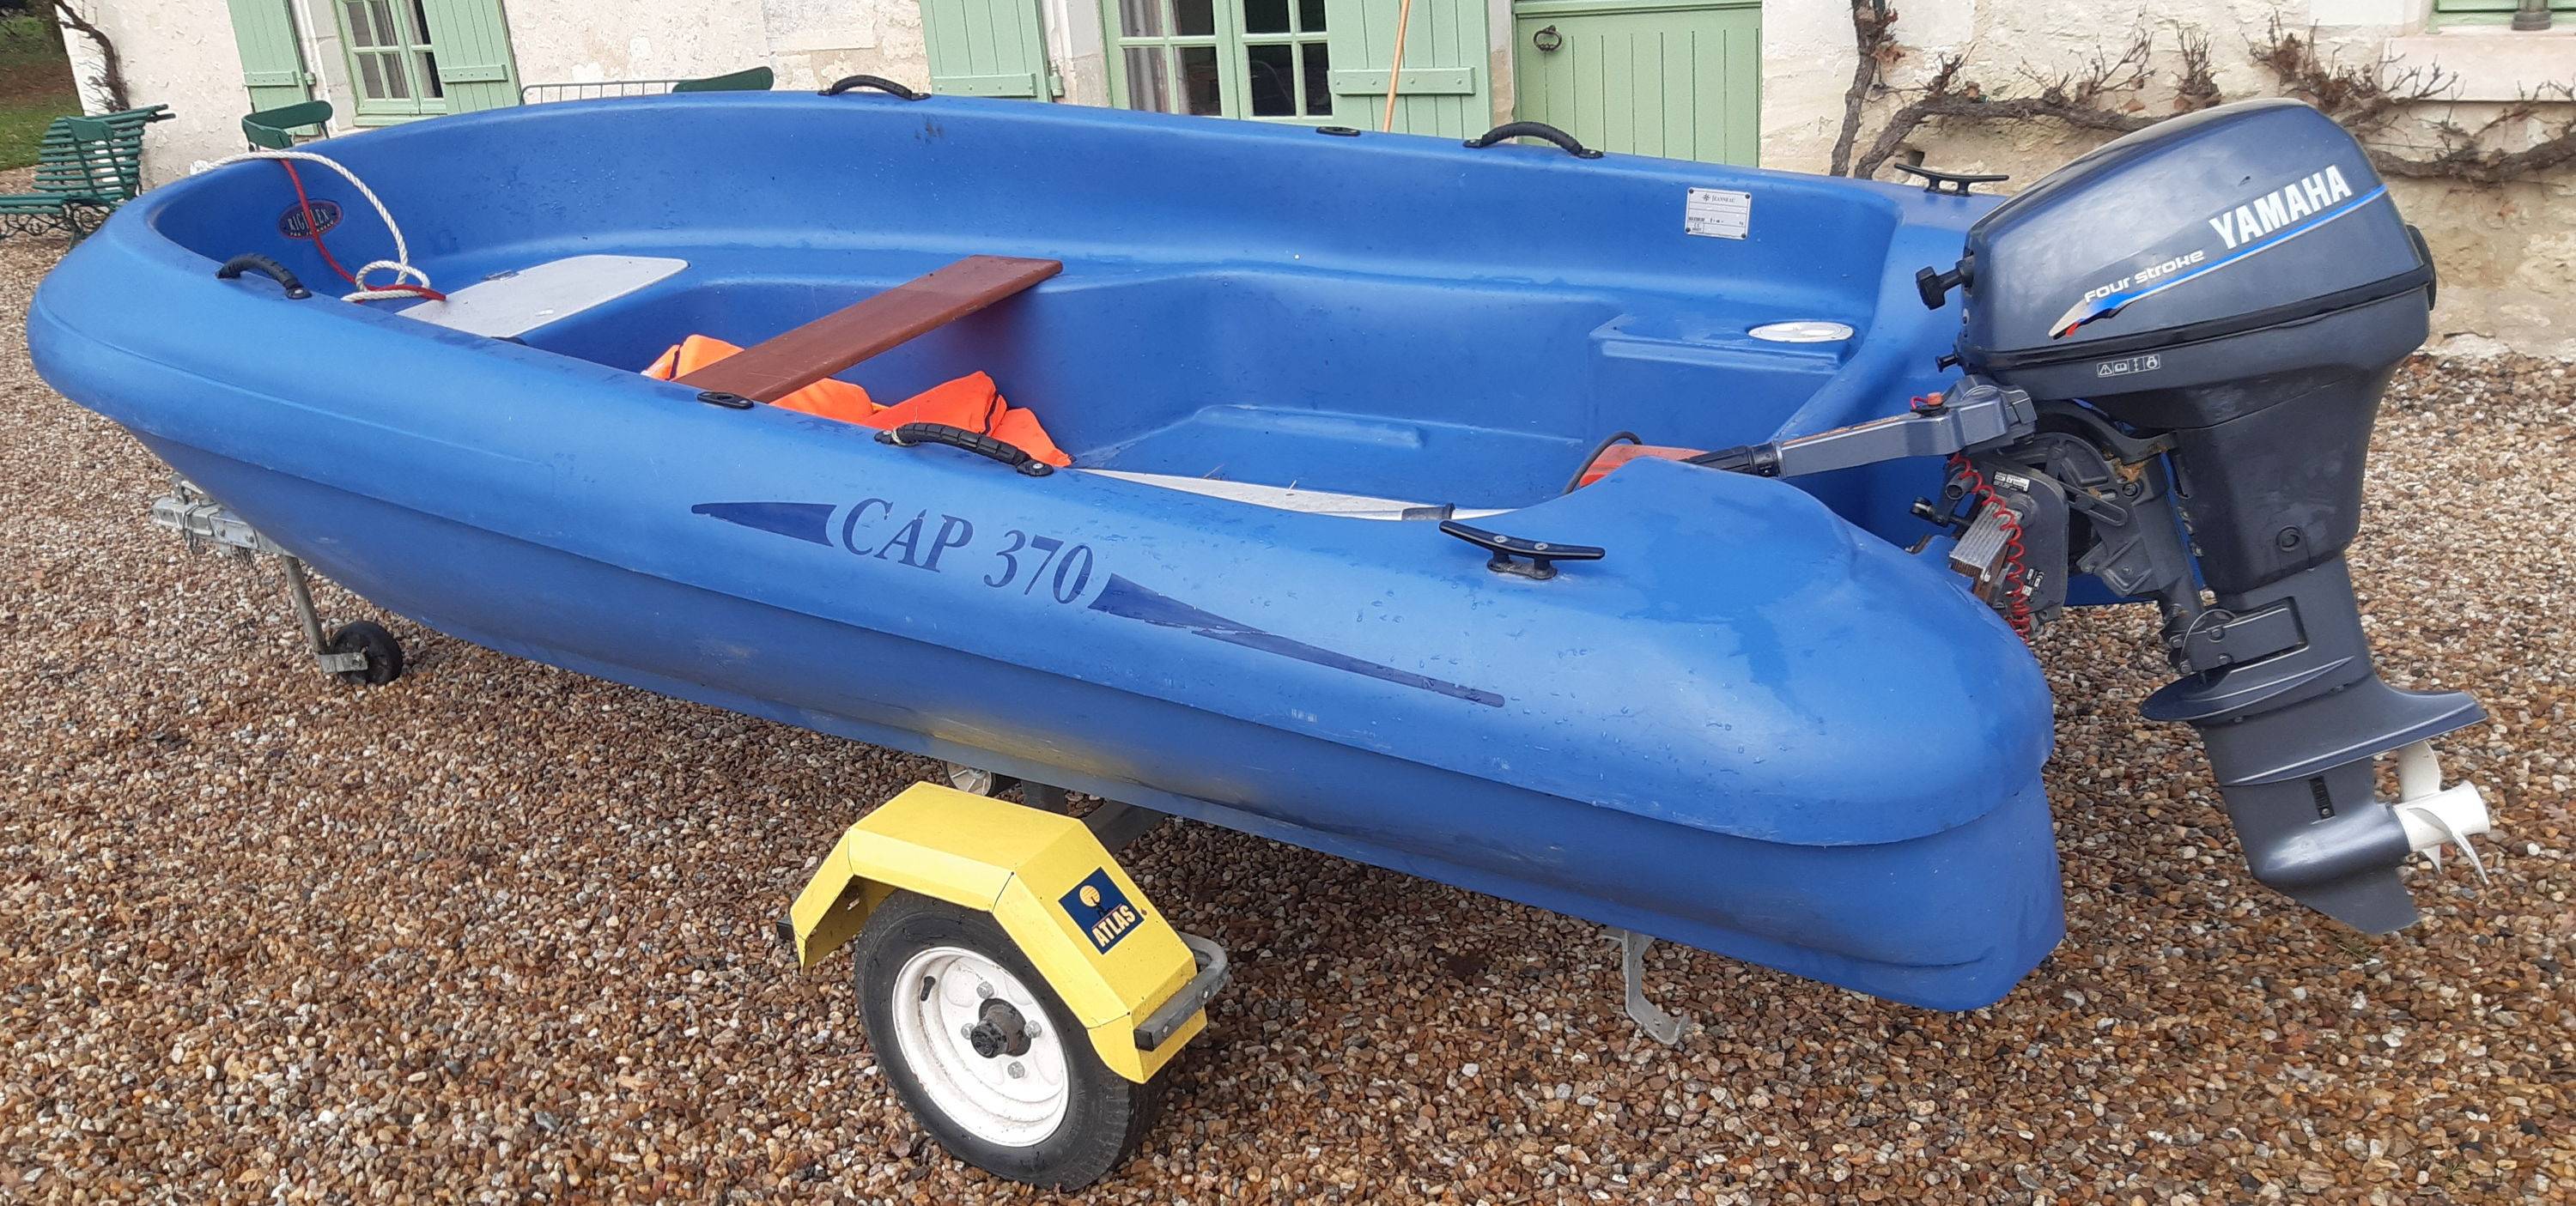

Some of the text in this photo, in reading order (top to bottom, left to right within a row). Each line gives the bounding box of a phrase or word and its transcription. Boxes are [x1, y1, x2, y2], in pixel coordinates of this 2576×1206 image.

[2208, 165, 2352, 250] YAMAHA
[841, 498, 1093, 604] CAP 370
[1091, 905, 1136, 948] ATLAS
